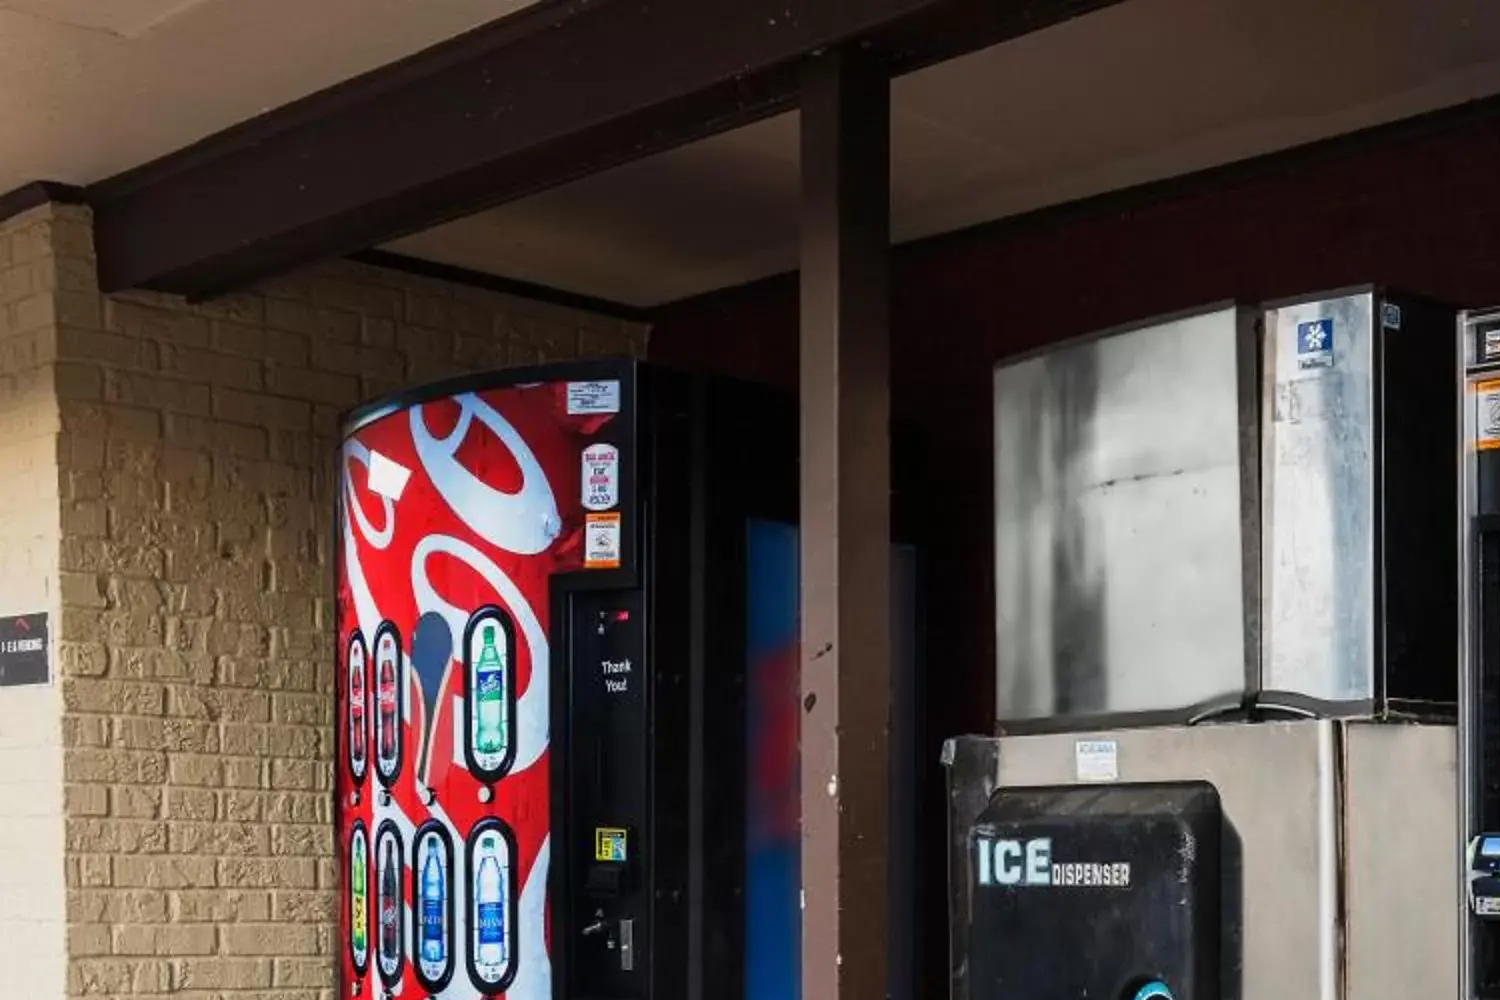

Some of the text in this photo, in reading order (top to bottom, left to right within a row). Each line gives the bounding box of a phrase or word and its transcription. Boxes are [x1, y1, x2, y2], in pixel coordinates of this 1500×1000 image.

[601, 658, 633, 676] Thank
[977, 837, 1131, 887] ICE DISPENSER
